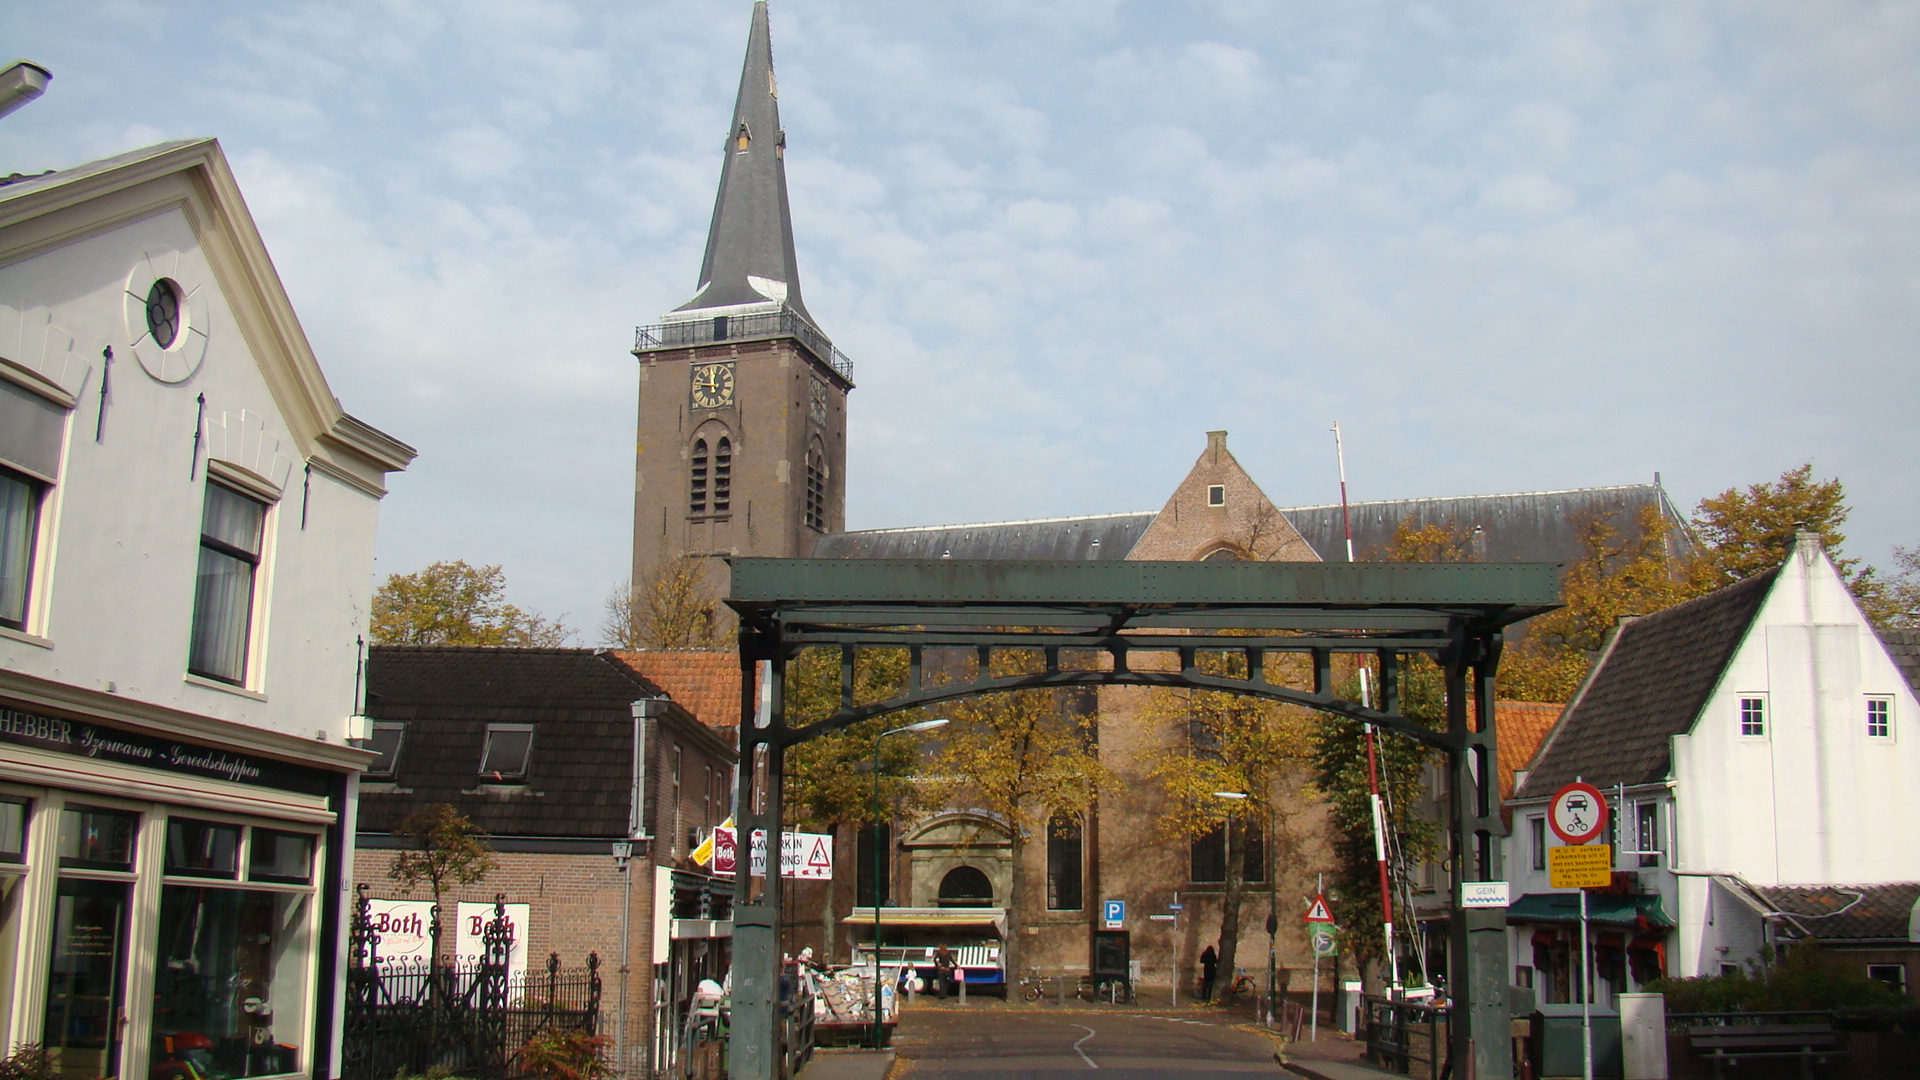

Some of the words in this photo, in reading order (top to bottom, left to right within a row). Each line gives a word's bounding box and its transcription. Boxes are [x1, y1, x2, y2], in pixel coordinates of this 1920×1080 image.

[171, 745, 261, 781] Gereedschappen
[716, 845, 736, 861] Both
[1476, 887, 1497, 895] GEIN
[1108, 903, 1121, 919] P
[374, 912, 424, 938] Both
